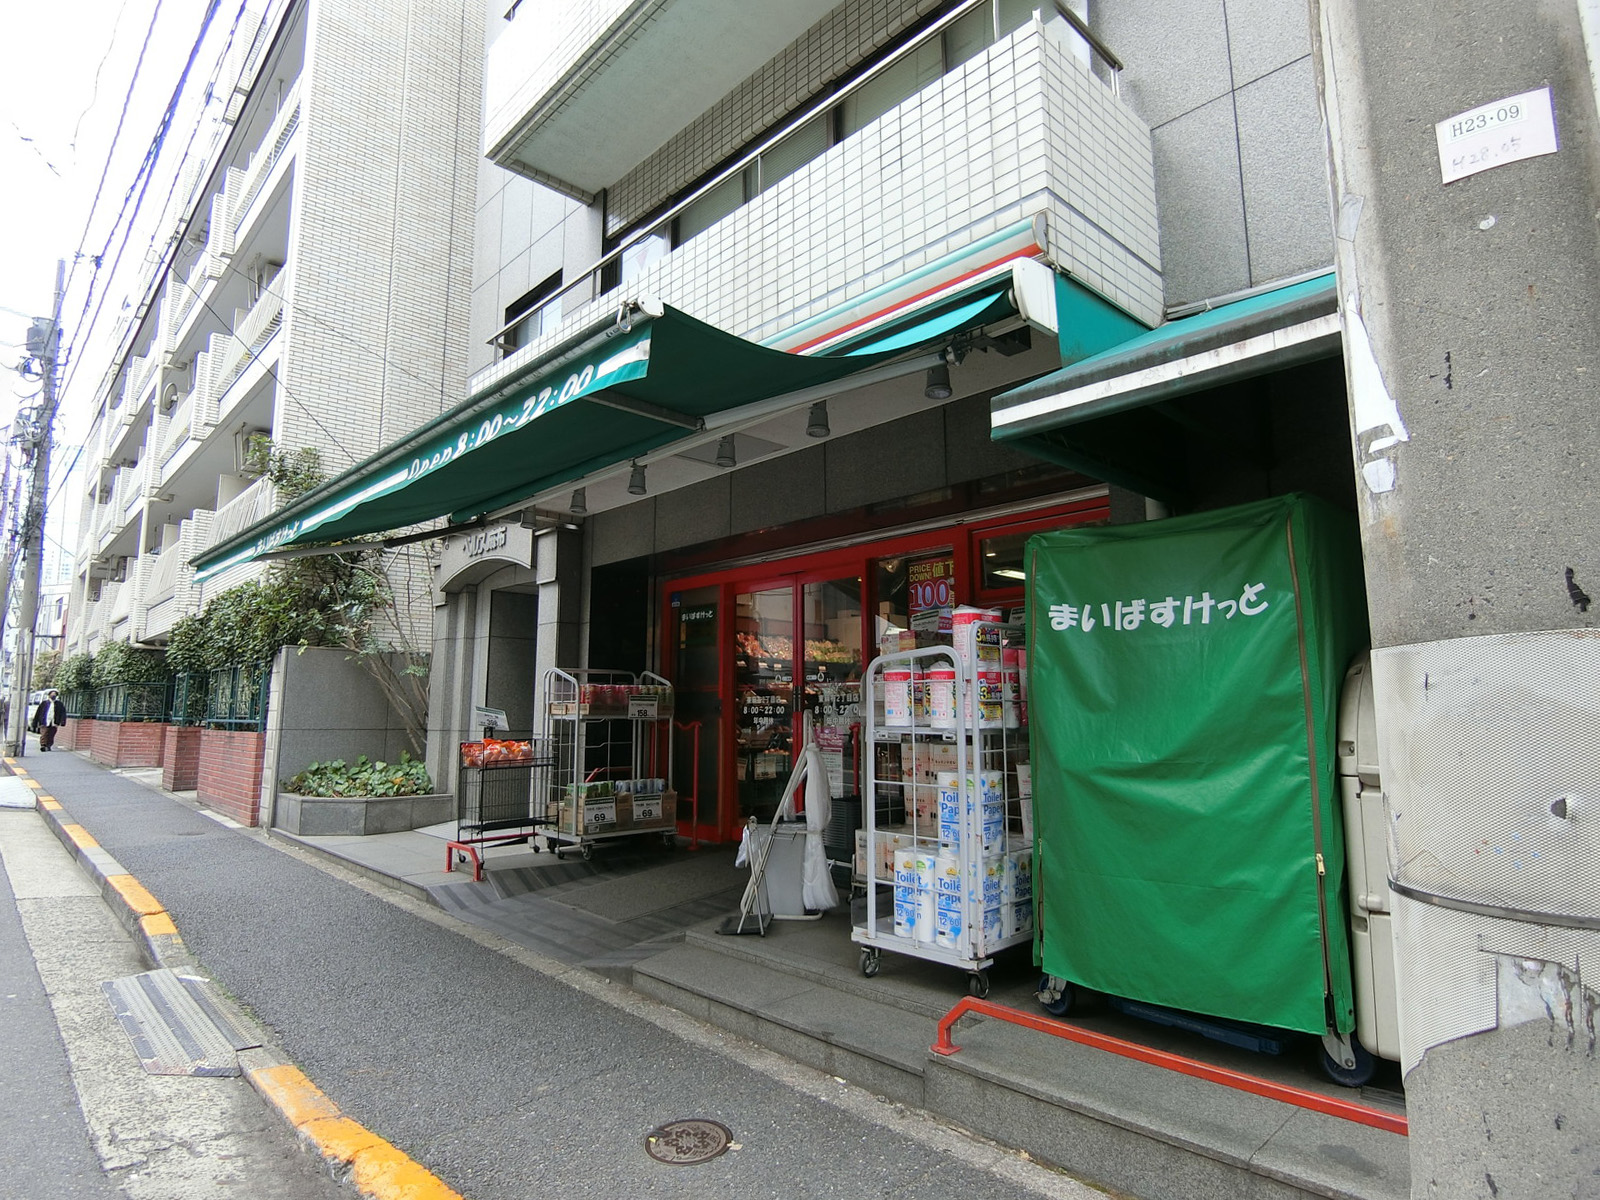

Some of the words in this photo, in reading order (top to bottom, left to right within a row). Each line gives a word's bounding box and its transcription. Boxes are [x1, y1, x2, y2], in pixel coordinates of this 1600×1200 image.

[407, 446, 453, 480] Open
[909, 563, 931, 574] PRICE
[909, 579, 950, 609] 100
[1048, 582, 1269, 633] まいばすけっと
[637, 709, 648, 717] 158
[941, 790, 970, 804] Toilt
[983, 791, 1002, 803] Toilet
[642, 809, 653, 818] 69
[941, 802, 972, 816] Papr
[983, 804, 1003, 816] Paper
[594, 813, 606, 822] 69
[938, 877, 962, 892] Toile
[938, 917, 947, 926] 12
